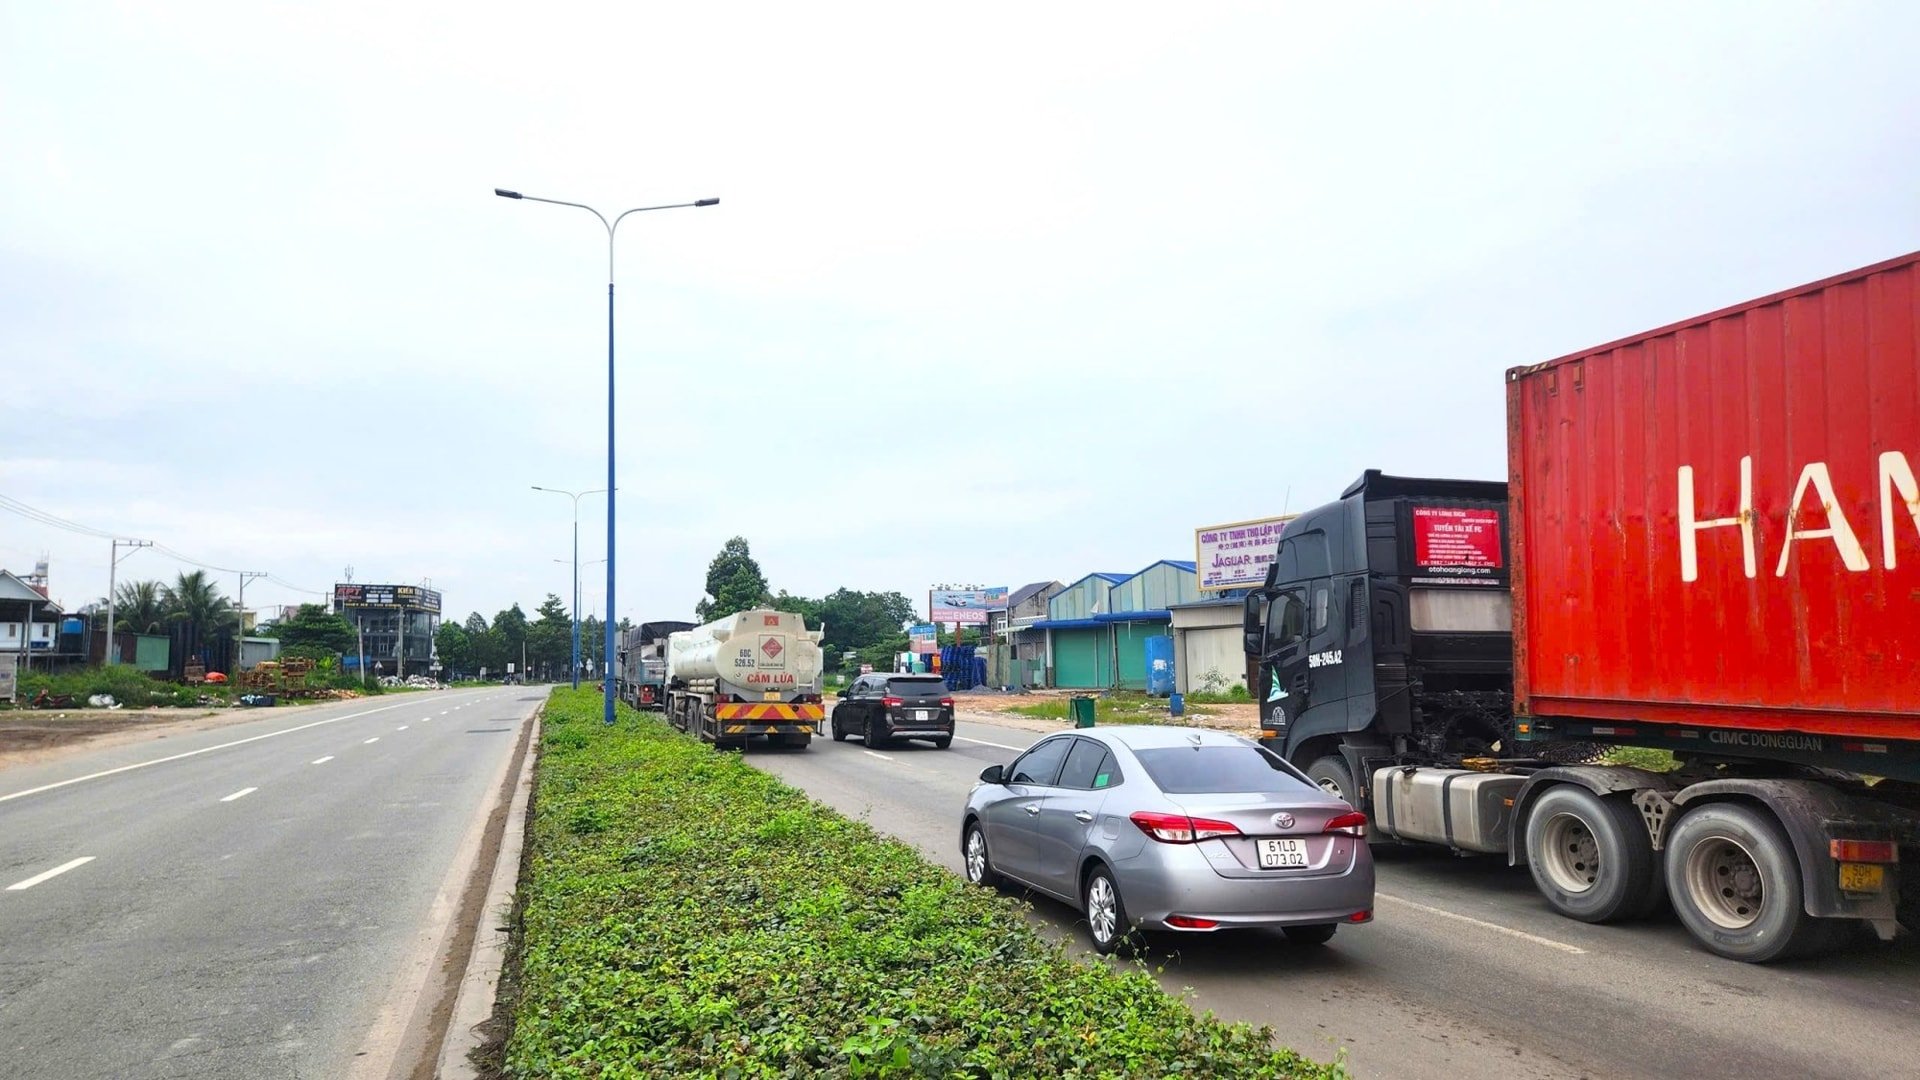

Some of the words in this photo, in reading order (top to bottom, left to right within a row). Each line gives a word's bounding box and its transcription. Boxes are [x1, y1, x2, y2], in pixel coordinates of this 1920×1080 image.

[1201, 532, 1218, 544] CÔNG
[1220, 532, 1229, 542] TY
[1229, 530, 1245, 541] TNHH
[1212, 553, 1252, 568] JAGUAR
[953, 611, 984, 620] ENEOS
[747, 671, 770, 684] CẤM
[1709, 730, 1749, 746] CIMC
[1751, 733, 1822, 751] DONGGUAN
[1268, 840, 1297, 852] 61LD
[1265, 853, 1304, 866] 073.02
